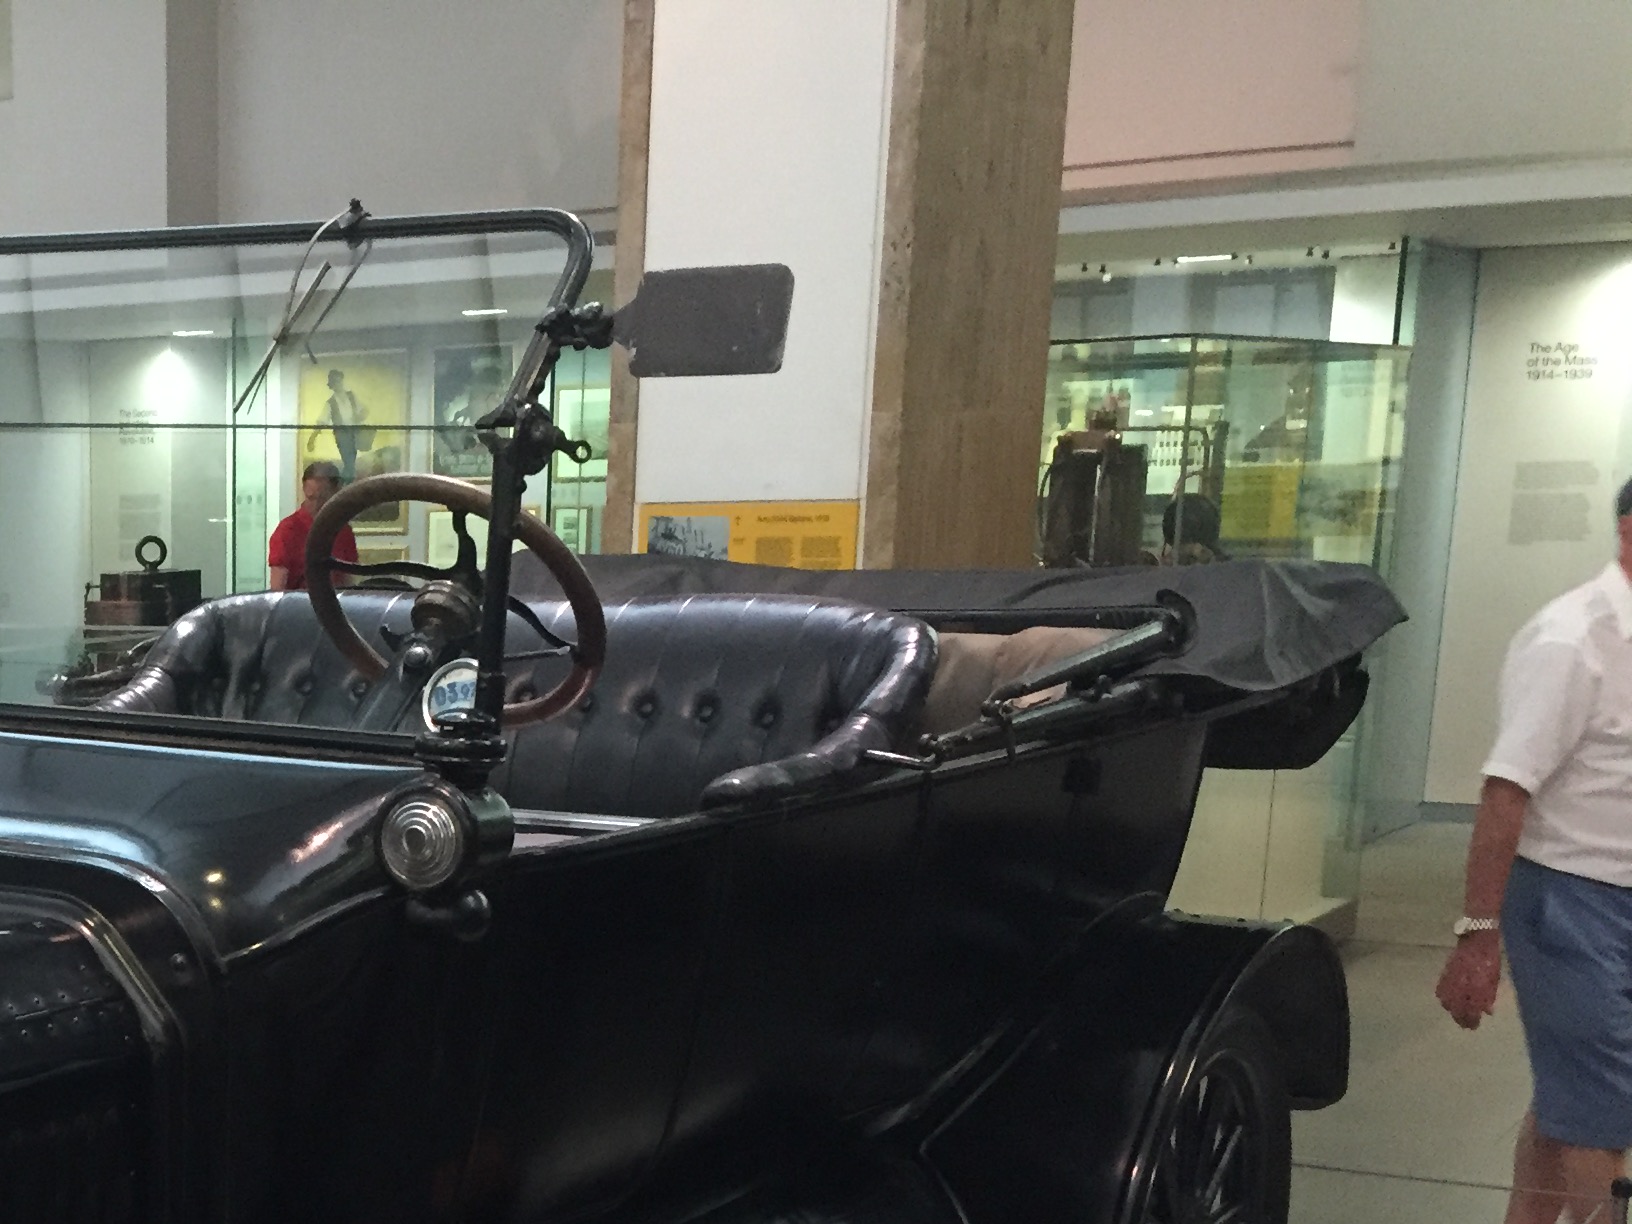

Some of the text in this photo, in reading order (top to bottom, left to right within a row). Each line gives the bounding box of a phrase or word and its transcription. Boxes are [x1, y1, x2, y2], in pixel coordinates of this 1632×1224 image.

[1530, 342, 1579, 357] The Age
[1527, 355, 1598, 367] of the Mass
